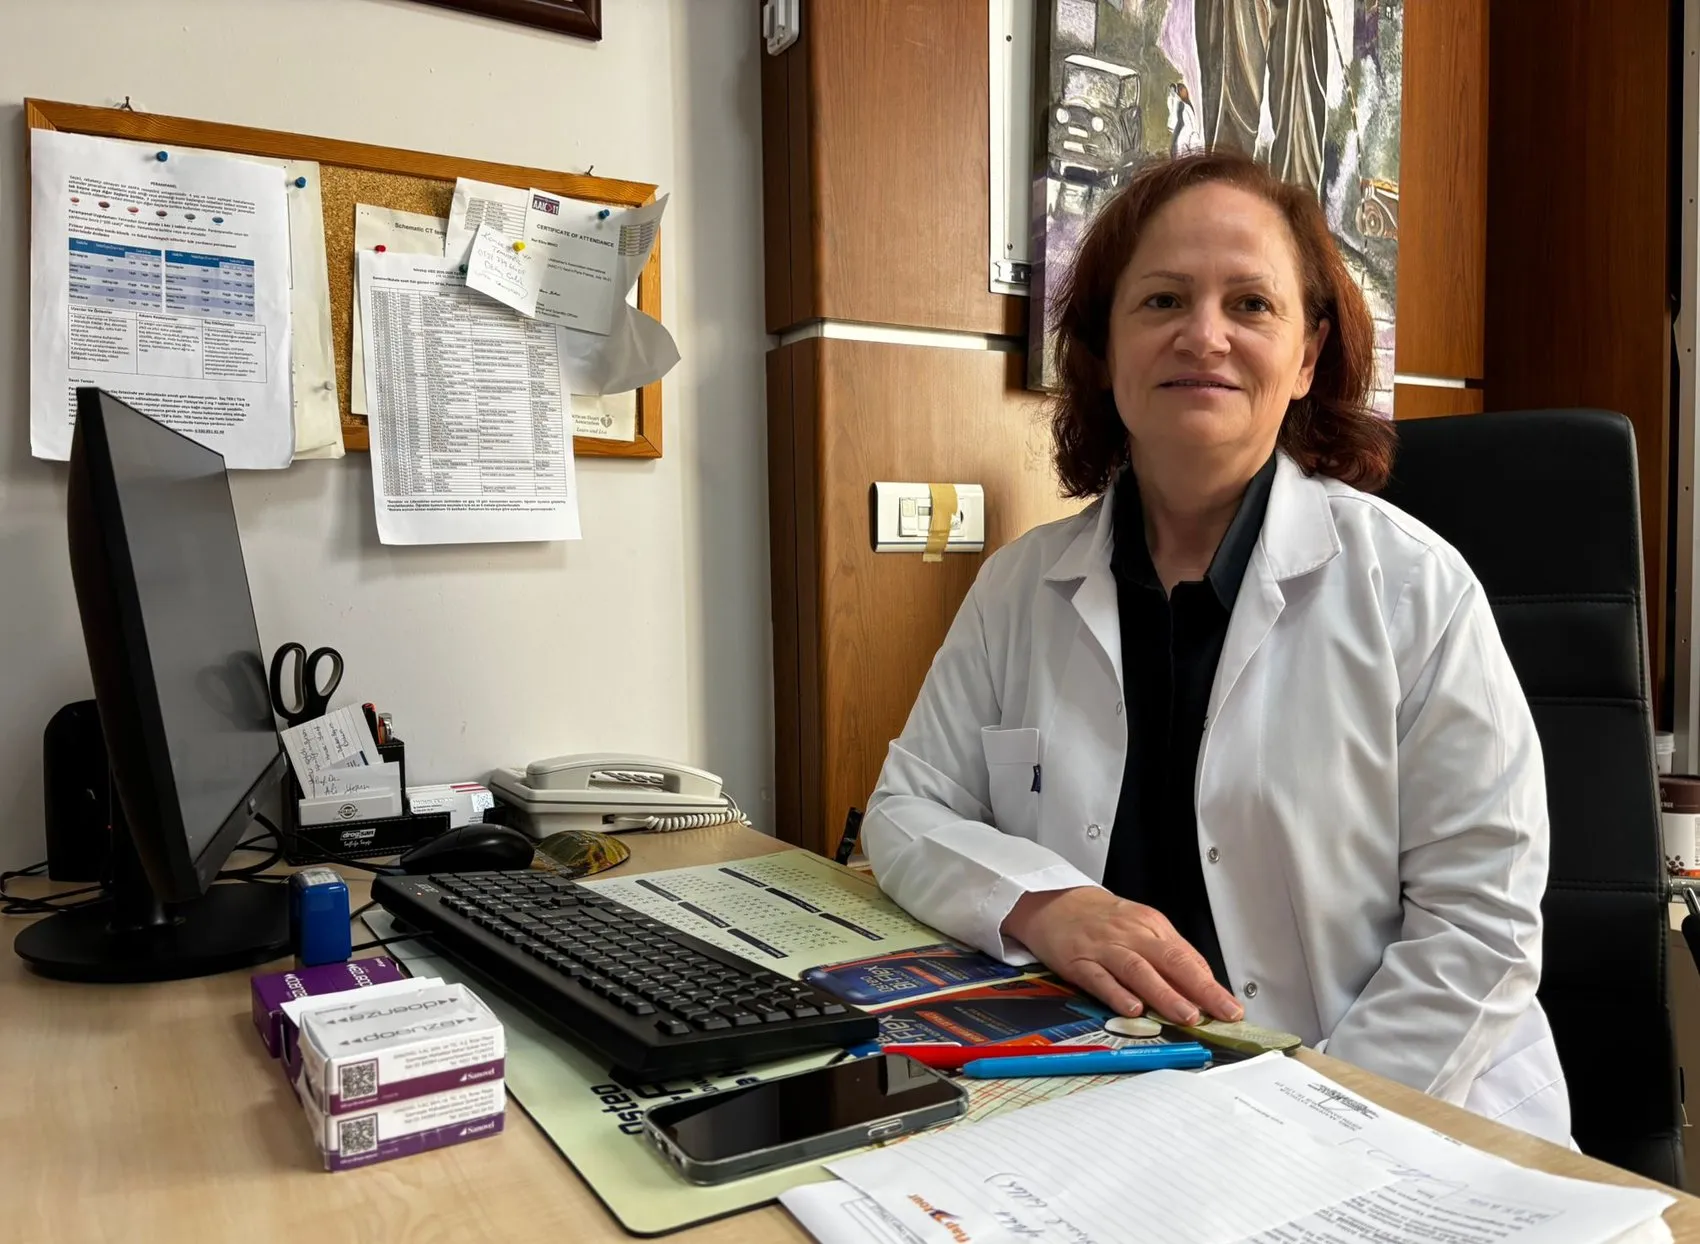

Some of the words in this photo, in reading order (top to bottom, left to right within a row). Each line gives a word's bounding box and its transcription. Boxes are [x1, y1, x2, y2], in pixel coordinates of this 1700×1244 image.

[395, 222, 424, 232] Schematic
[536, 224, 570, 237] CERTIFICATE
[579, 235, 614, 248] ATTENDANCE
[349, 1000, 438, 1022] doenza
[363, 1020, 456, 1043] doenza
[467, 1066, 495, 1080] Sanovel
[467, 1120, 495, 1134] Sanovel
